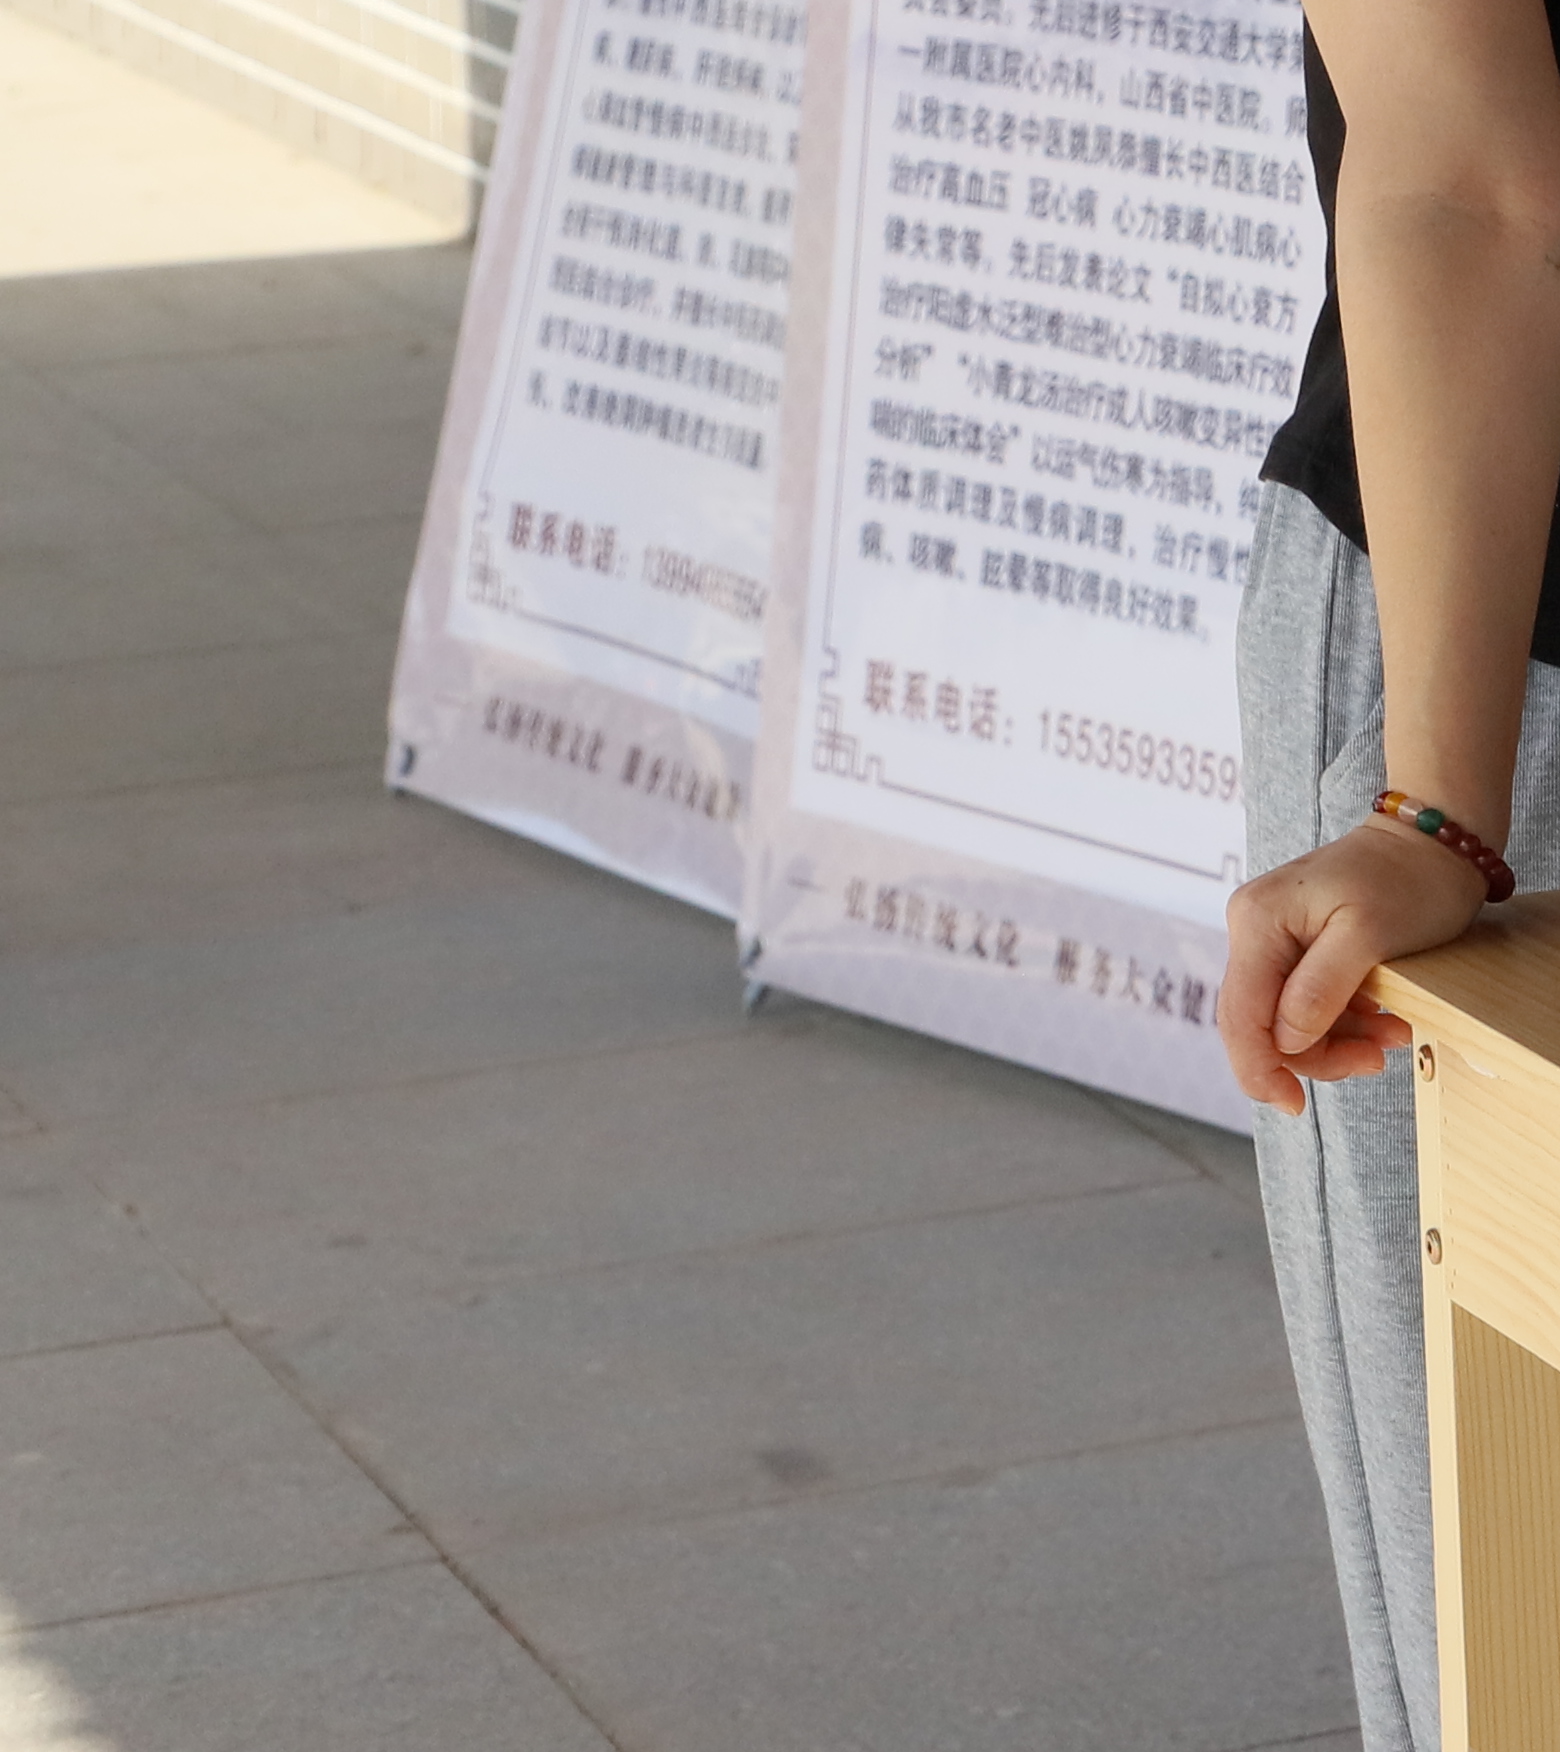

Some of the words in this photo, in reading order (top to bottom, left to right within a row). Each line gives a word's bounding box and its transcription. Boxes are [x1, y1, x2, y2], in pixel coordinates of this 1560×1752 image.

[1050, 934, 1224, 1031] 服务大众健
